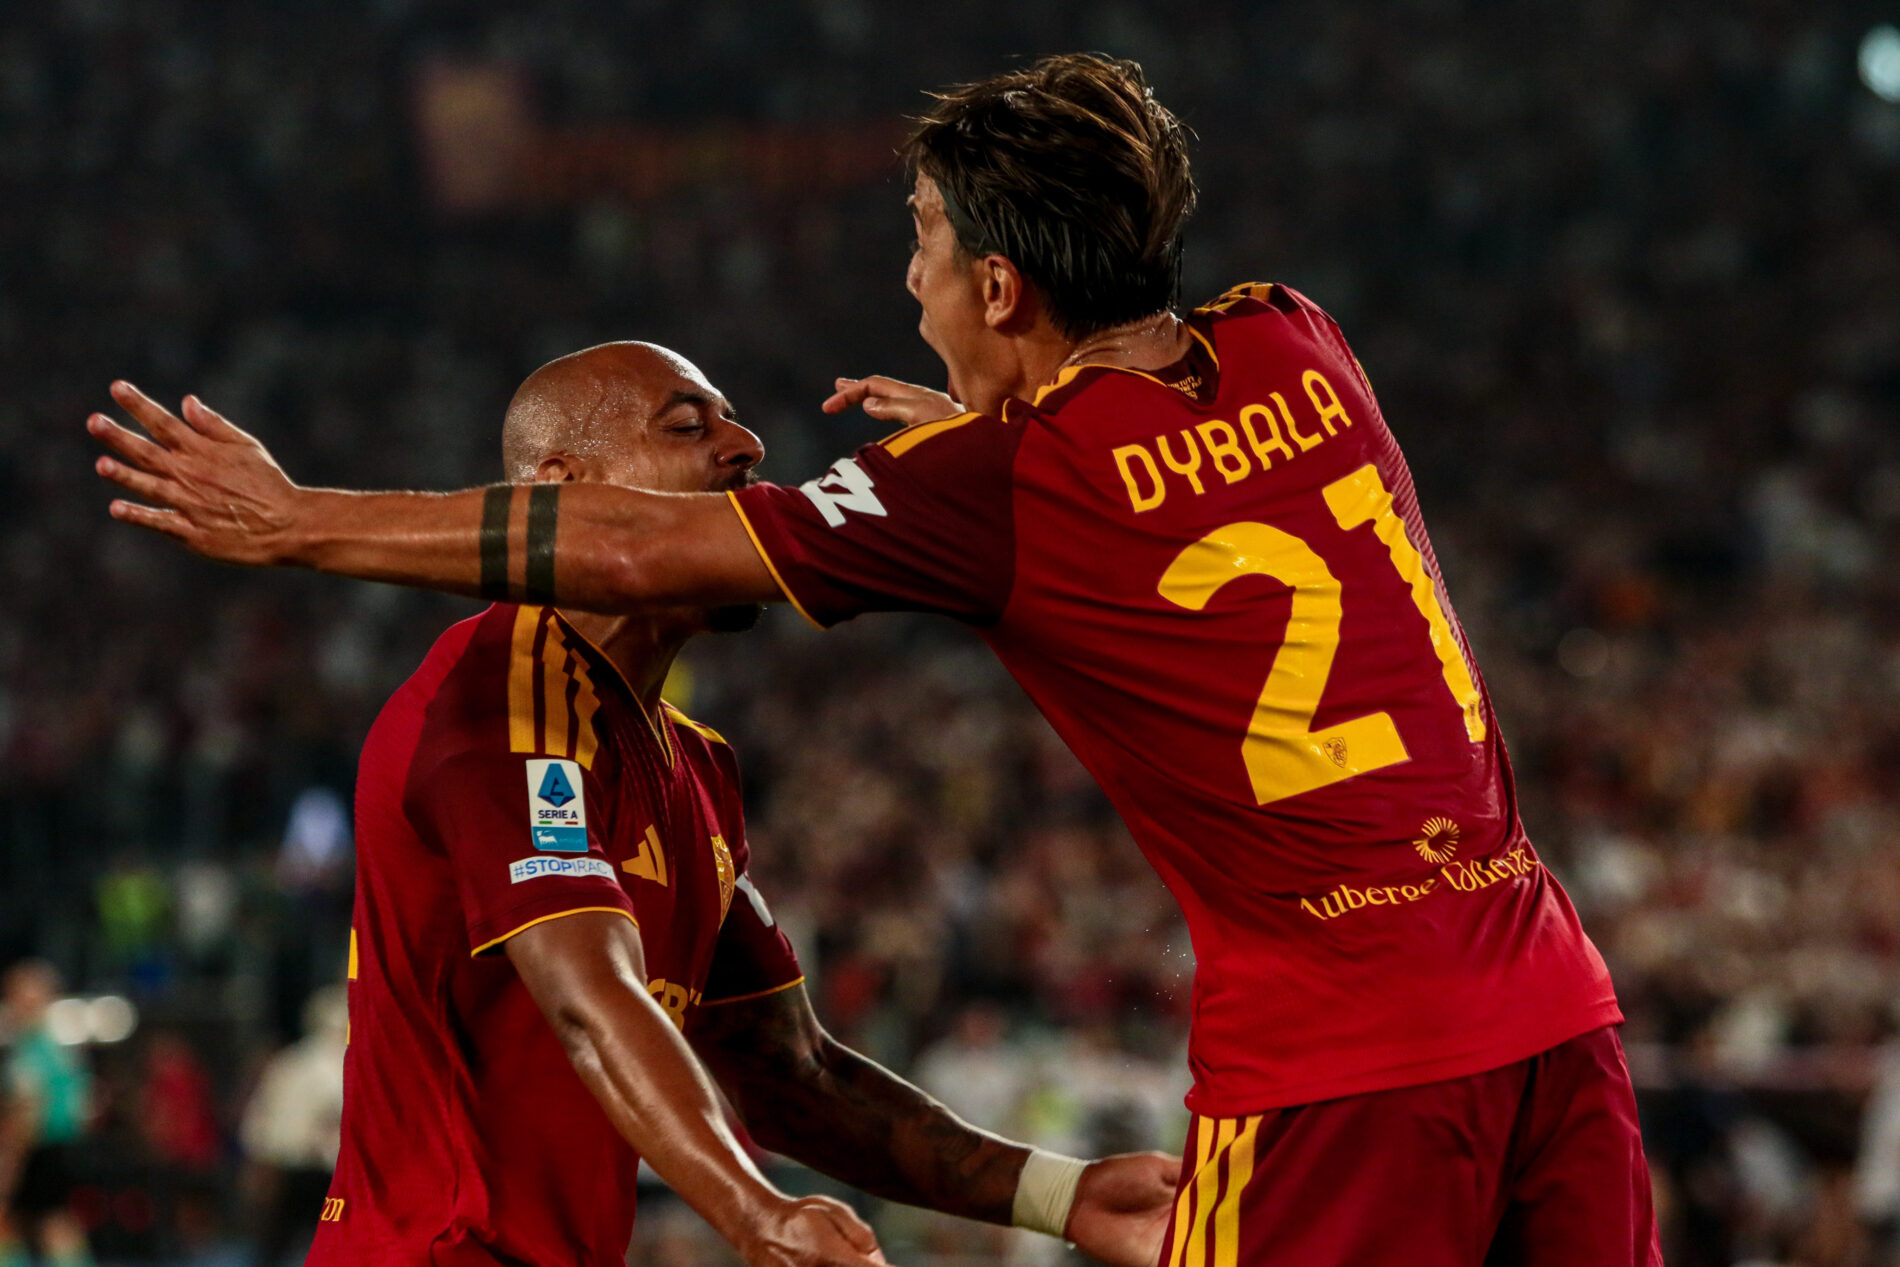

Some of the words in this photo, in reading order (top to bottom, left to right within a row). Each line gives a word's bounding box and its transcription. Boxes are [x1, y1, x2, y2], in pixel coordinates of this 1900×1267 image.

[1112, 369, 1352, 514] DYBALA
[1157, 464, 1487, 806] 21
[537, 809, 568, 819] SERIE
[570, 810, 578, 819] A
[513, 859, 612, 878] #STOPIRAC
